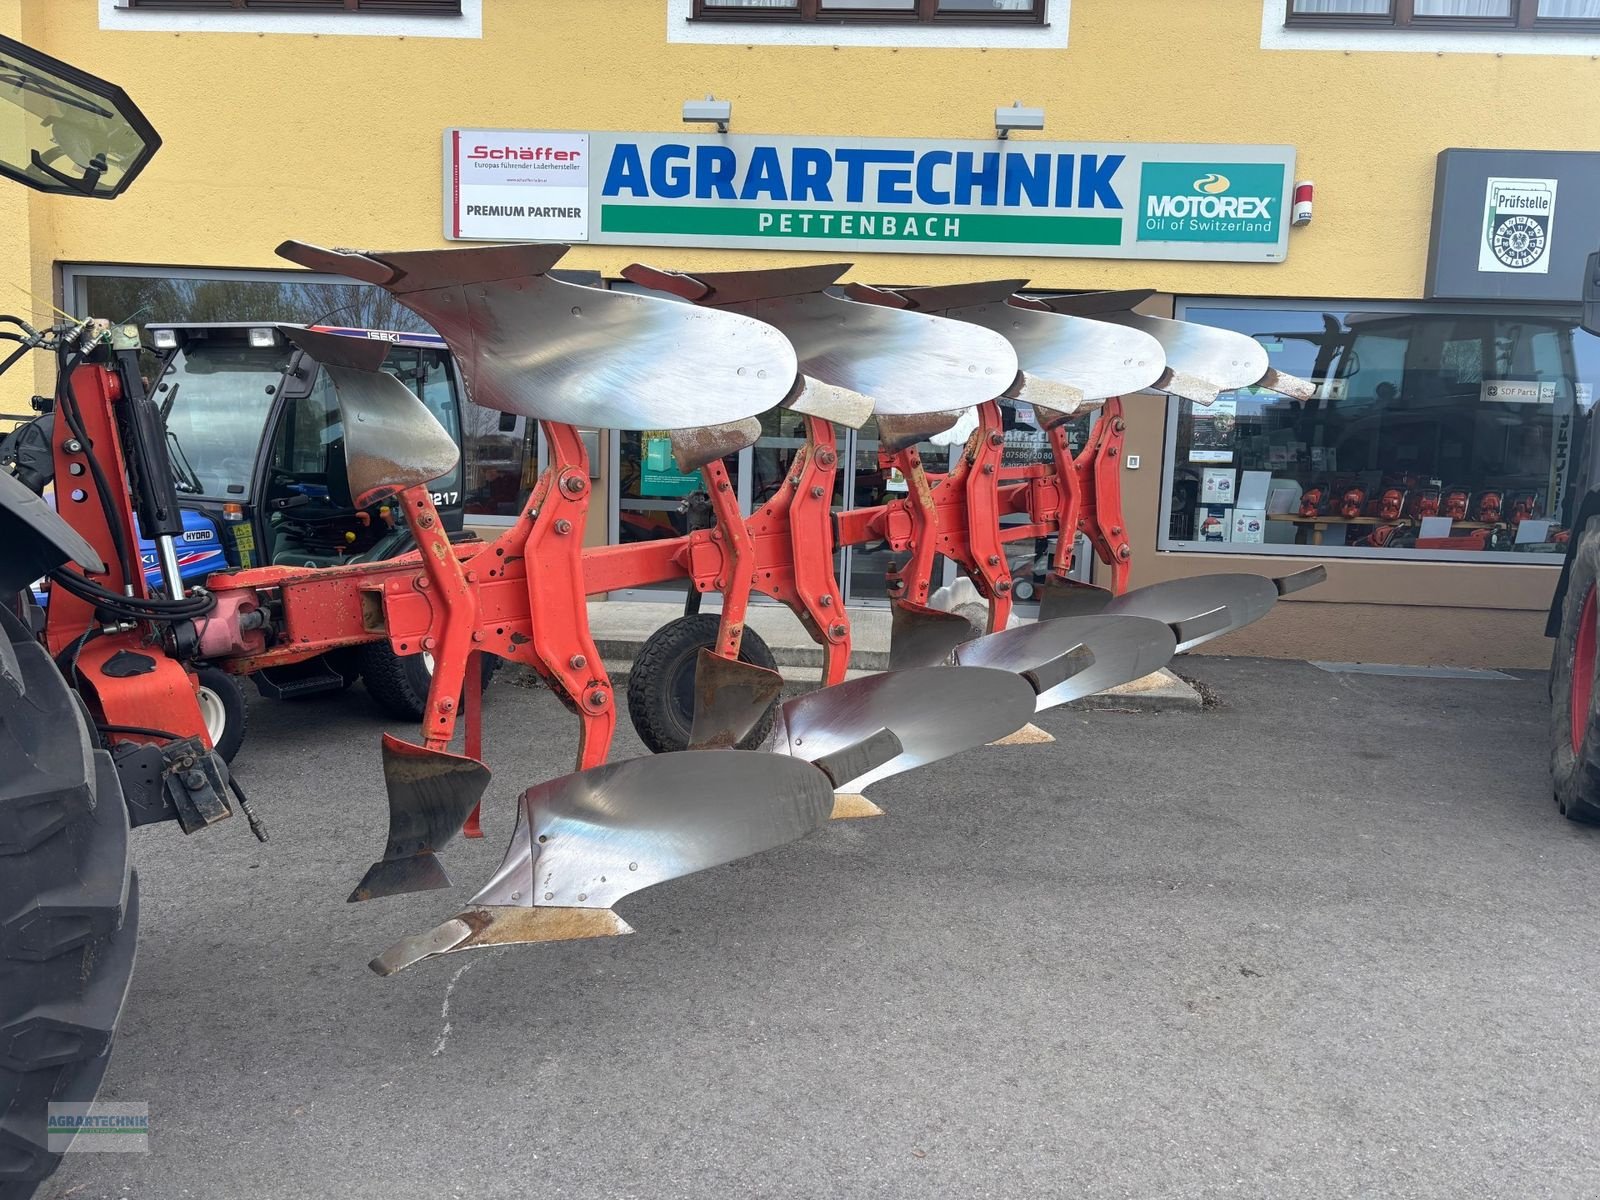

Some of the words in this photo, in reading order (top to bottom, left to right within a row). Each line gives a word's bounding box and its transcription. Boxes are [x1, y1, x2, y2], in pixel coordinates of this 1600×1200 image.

[467, 146, 581, 161] Schäffer
[475, 161, 499, 170] Europas
[501, 161, 532, 170] führender
[533, 163, 580, 171] Laderhersteller
[602, 143, 1126, 209] AGRARTECHNIK
[1147, 195, 1273, 219] MOTOREX
[1499, 194, 1548, 209] Prüfstelle
[467, 205, 525, 217] PREMIUM
[528, 207, 582, 218] PARTNER
[759, 213, 960, 237] PETTENBACH
[1146, 218, 1164, 230] Oil
[1170, 220, 1184, 231] of
[1189, 219, 1272, 232] Switzerland
[367, 331, 400, 342] ISEKI
[1501, 387, 1516, 395] SDF
[1517, 388, 1537, 396] Parts
[186, 531, 211, 540] HYDRO
